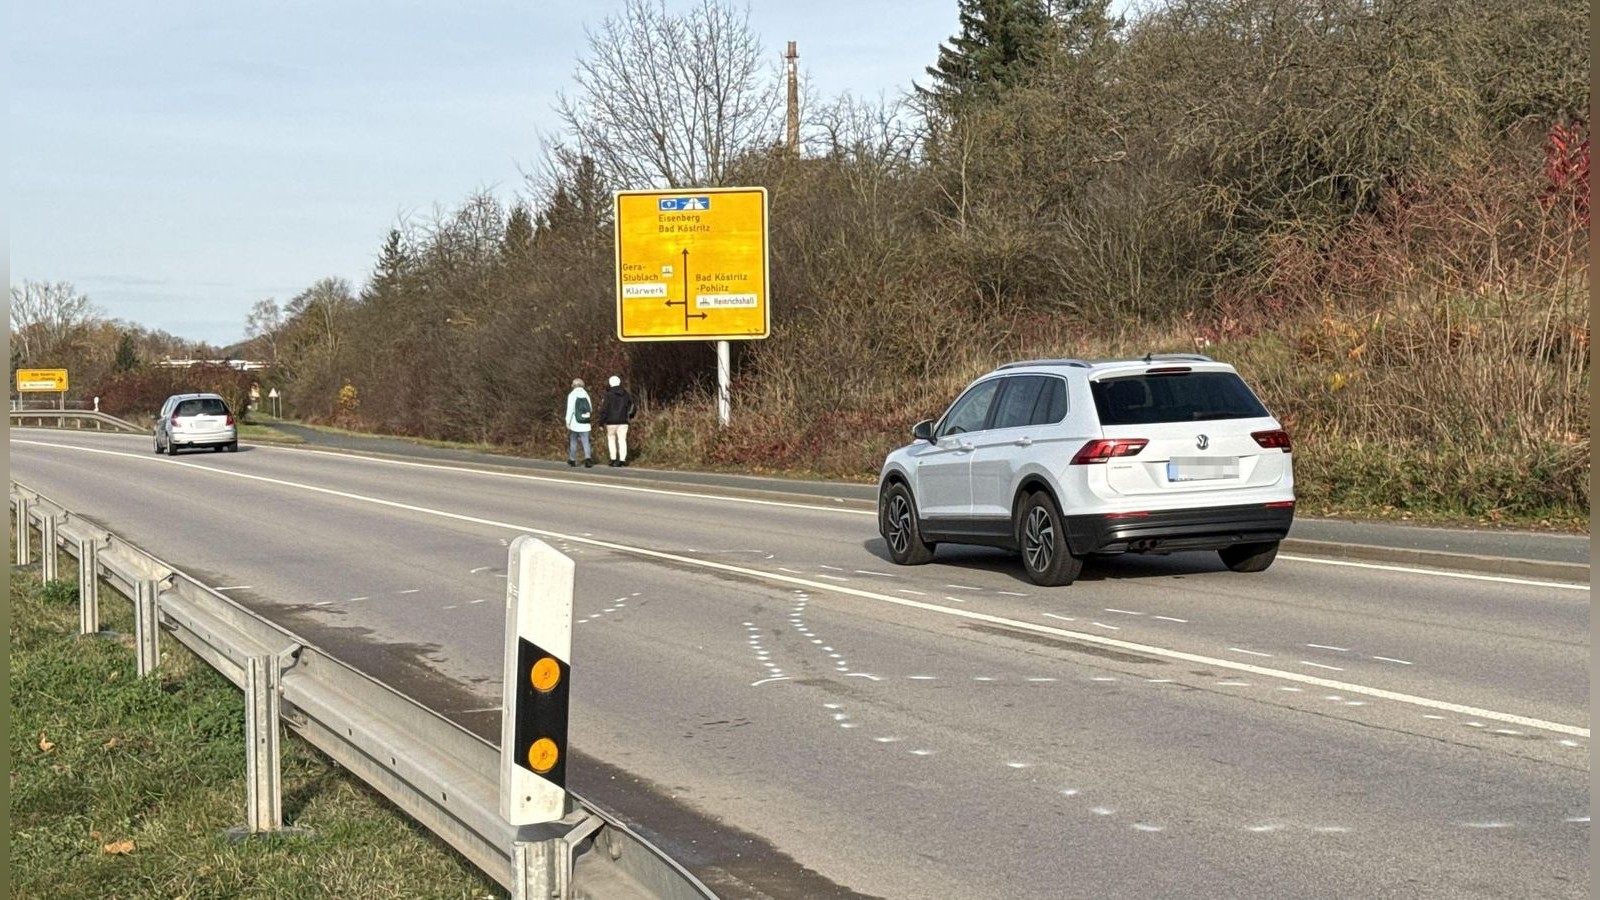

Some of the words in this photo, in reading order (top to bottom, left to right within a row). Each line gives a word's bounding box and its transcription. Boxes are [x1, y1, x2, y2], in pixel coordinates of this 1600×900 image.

[658, 214, 700, 223] Eisenberg
[678, 224, 710, 232] Köstritz
[622, 263, 646, 271] Gera-
[695, 273, 711, 281] Bad
[714, 272, 748, 280] Köstritz
[696, 284, 729, 292] -Pohlitz
[713, 297, 755, 305] Heinrichshall
